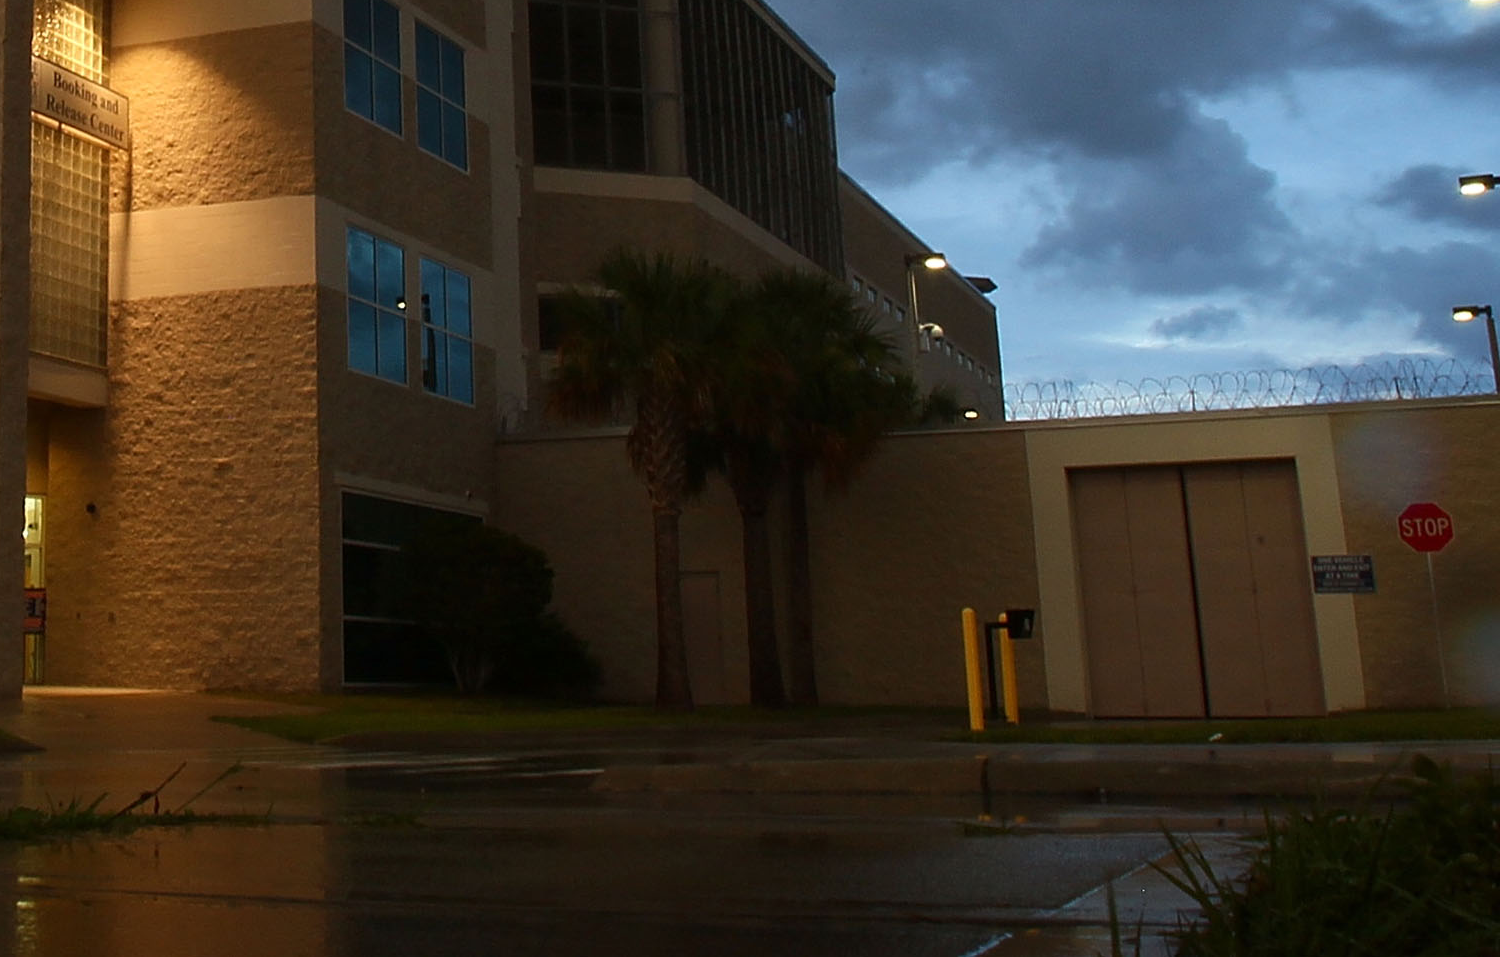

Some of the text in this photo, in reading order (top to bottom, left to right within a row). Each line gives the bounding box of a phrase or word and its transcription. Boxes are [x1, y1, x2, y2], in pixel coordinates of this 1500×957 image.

[53, 71, 98, 108] Booking
[100, 97, 119, 116] and
[46, 93, 125, 141] Release Center
[1402, 518, 1449, 537] STOP
